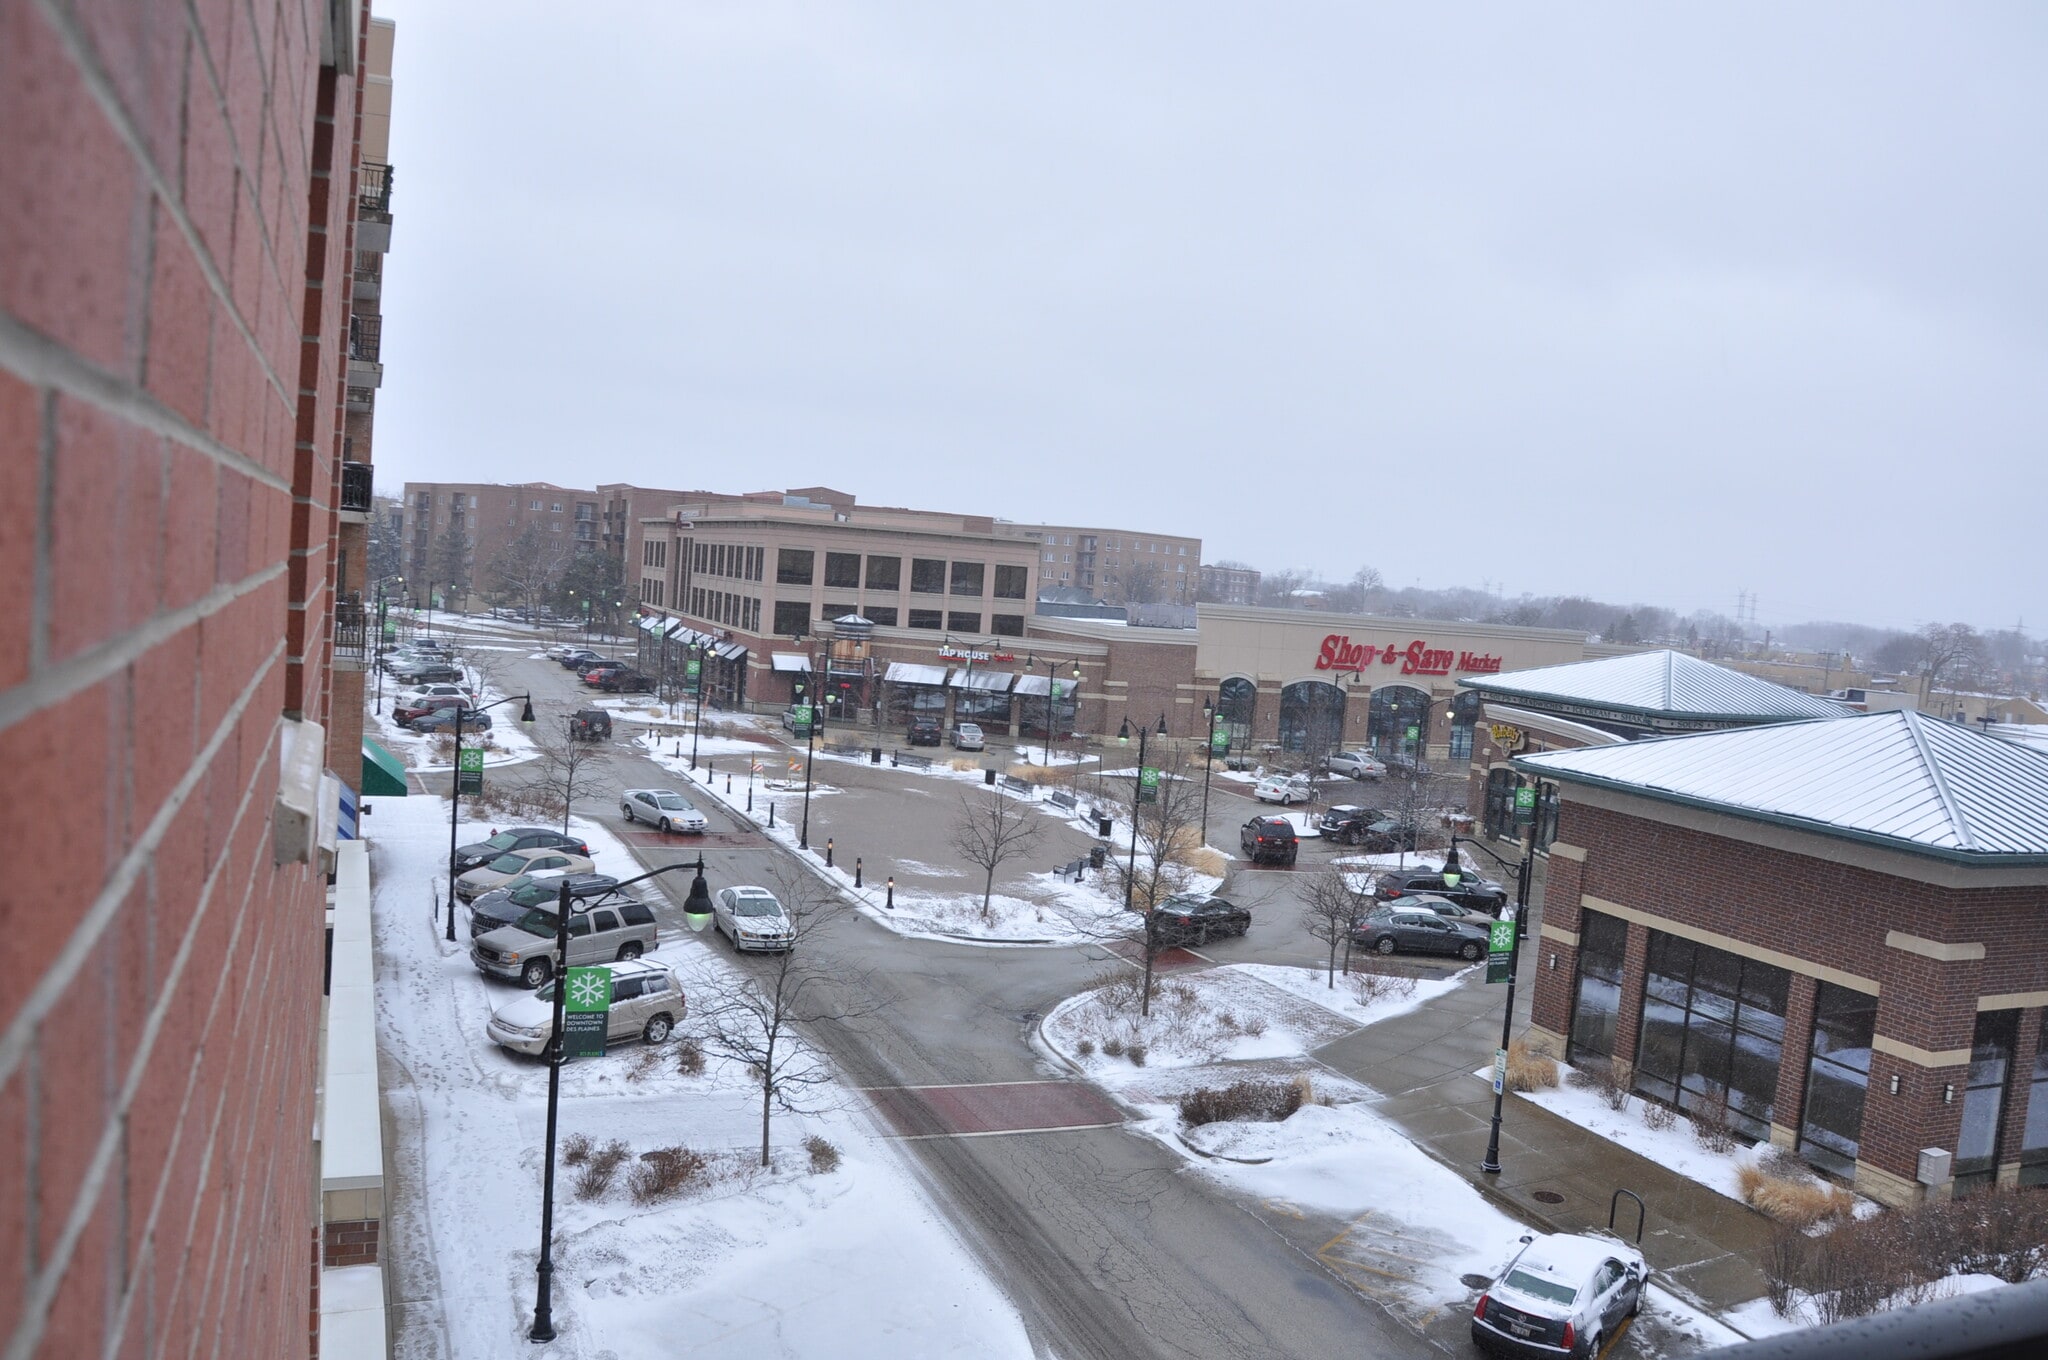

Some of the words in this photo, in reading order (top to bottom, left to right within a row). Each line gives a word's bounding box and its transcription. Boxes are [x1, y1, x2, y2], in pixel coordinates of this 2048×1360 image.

[938, 648, 956, 658] TAP
[957, 651, 990, 661] HOUSE
[1455, 651, 1502, 673] Market
